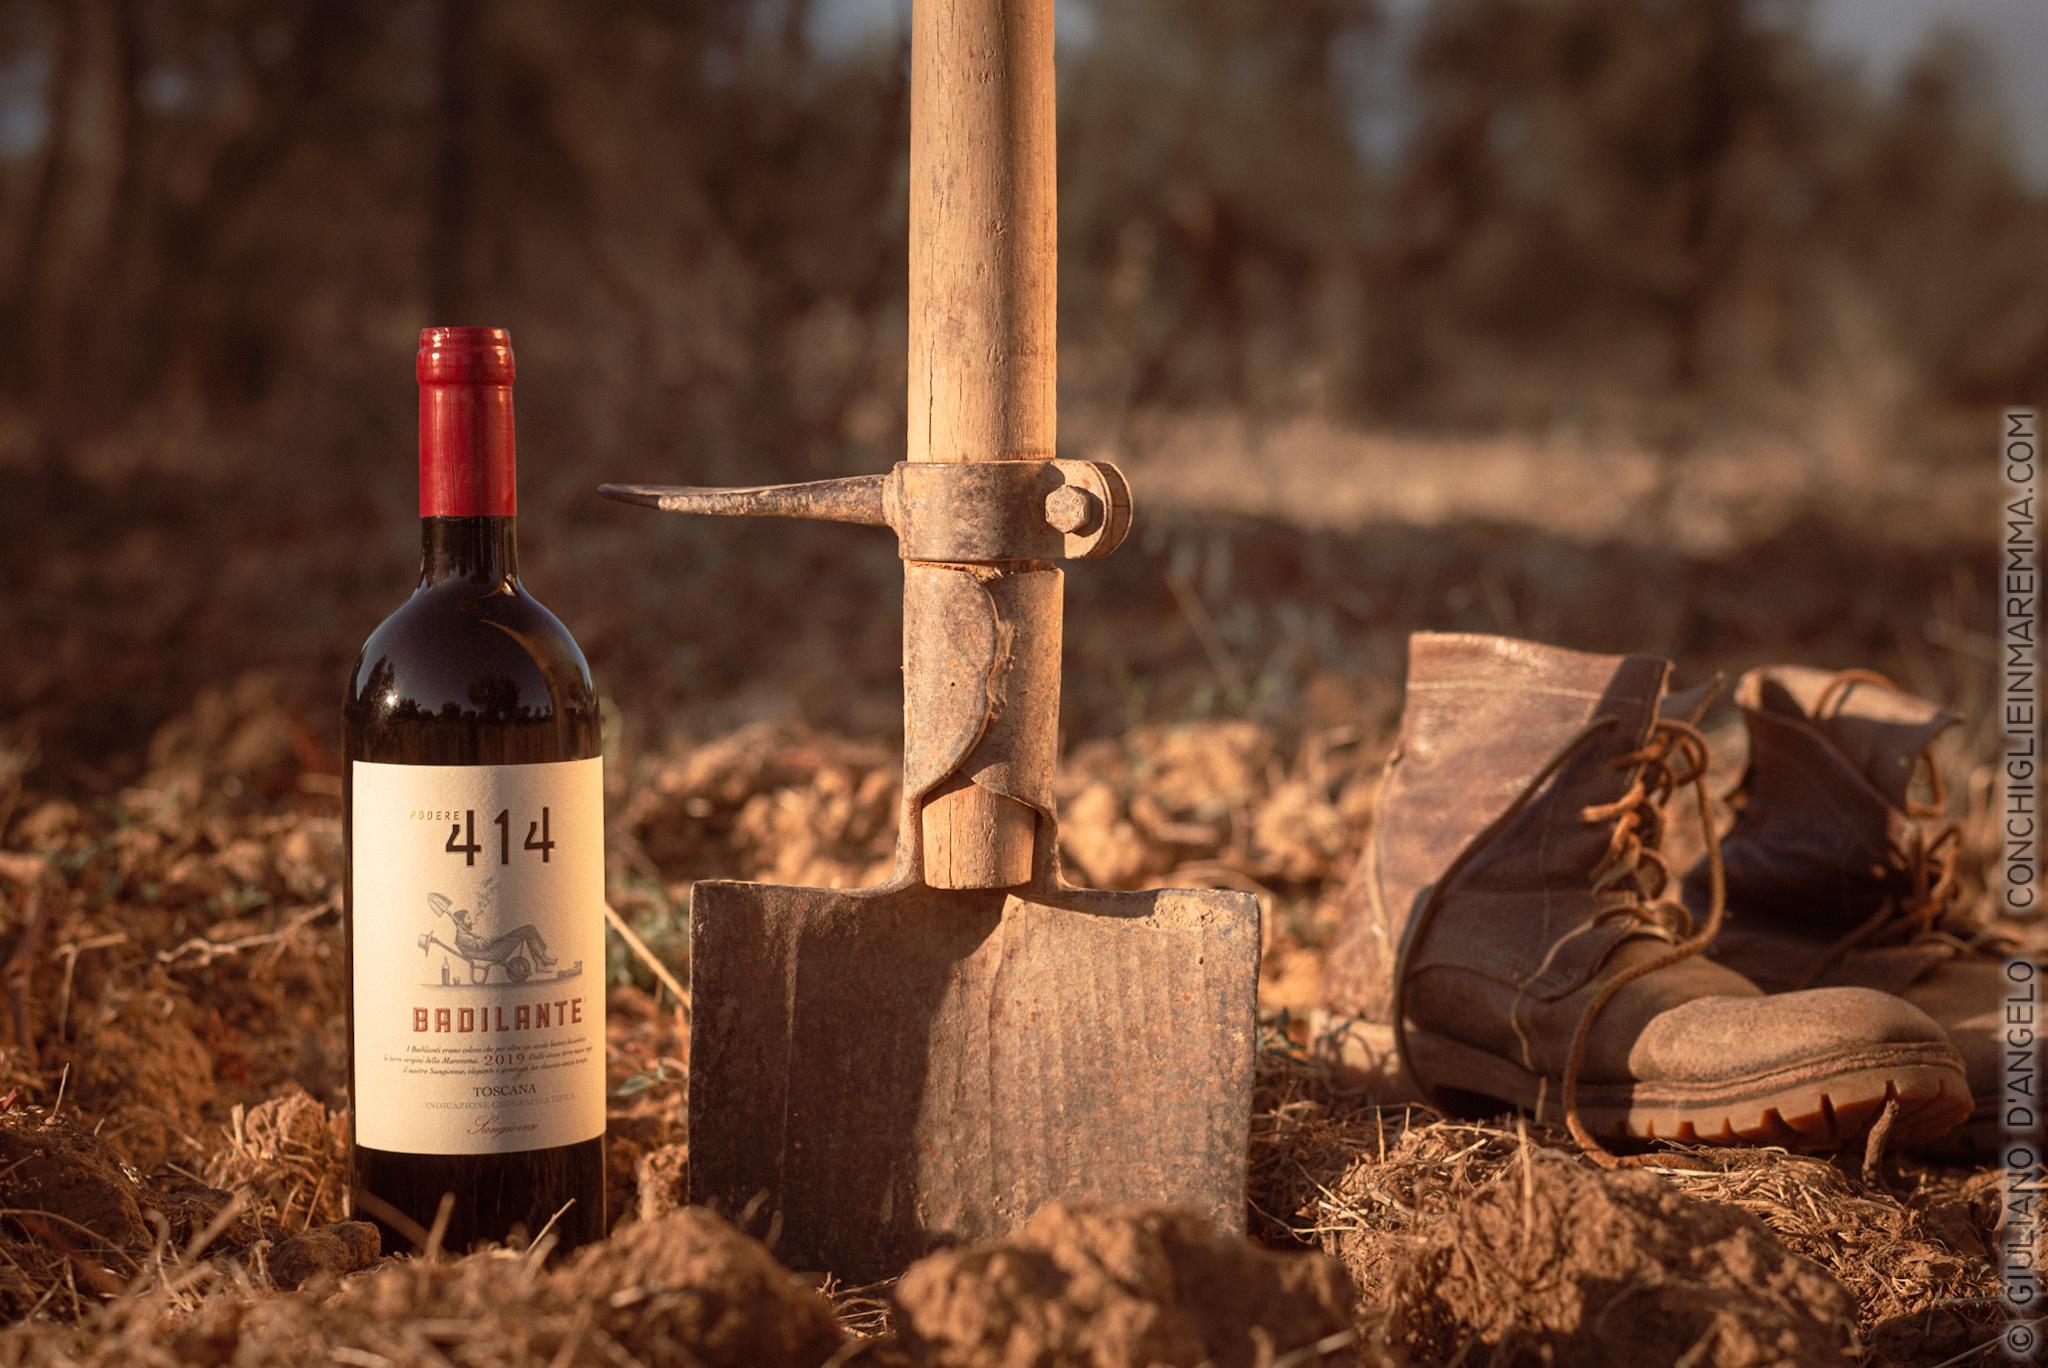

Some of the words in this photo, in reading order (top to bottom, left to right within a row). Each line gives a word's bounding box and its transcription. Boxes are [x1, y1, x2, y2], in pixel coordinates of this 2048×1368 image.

[409, 810, 460, 821] PODERE
[445, 807, 555, 866] 414
[412, 997, 583, 1033] BADILANTE
[483, 1053, 525, 1066] 2019
[473, 1084, 537, 1097] TOSCANA
[425, 1101, 488, 1111] INDICAZIONE
